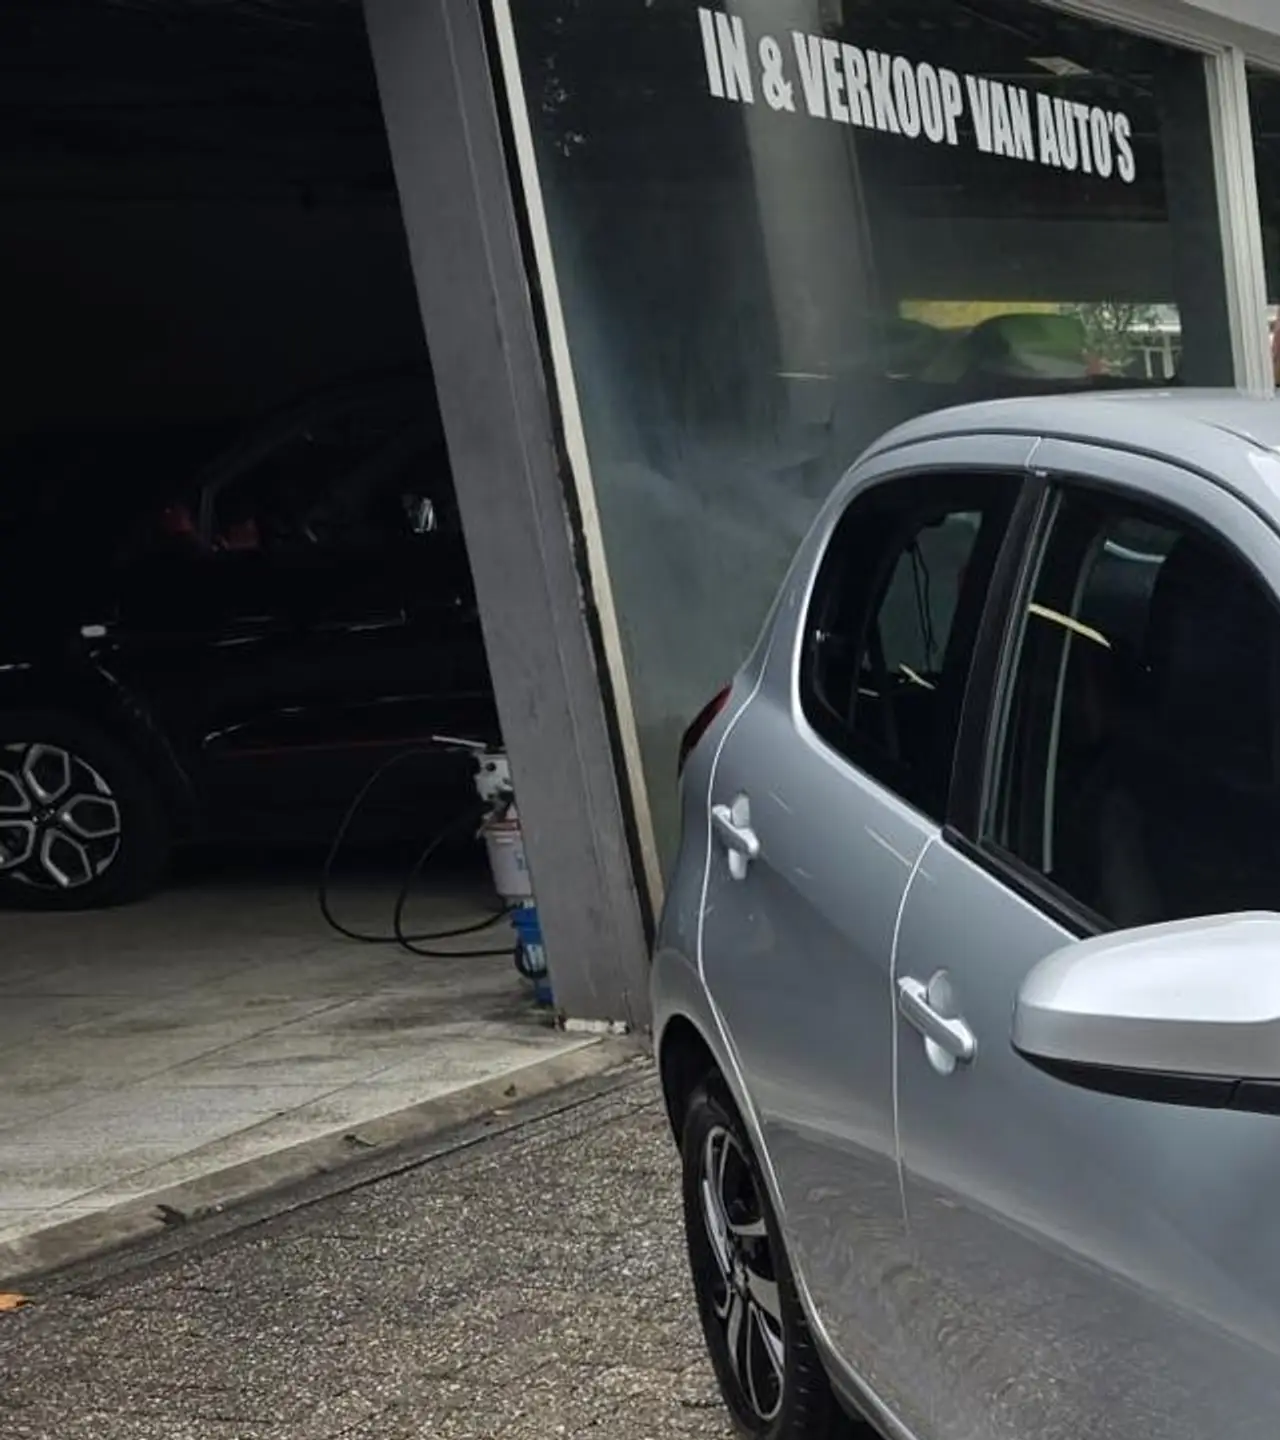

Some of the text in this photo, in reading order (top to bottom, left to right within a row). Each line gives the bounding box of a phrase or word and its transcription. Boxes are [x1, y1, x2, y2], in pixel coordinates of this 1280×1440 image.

[697, 7, 1137, 184] IN & VERKOOP VAN AUTO'S
